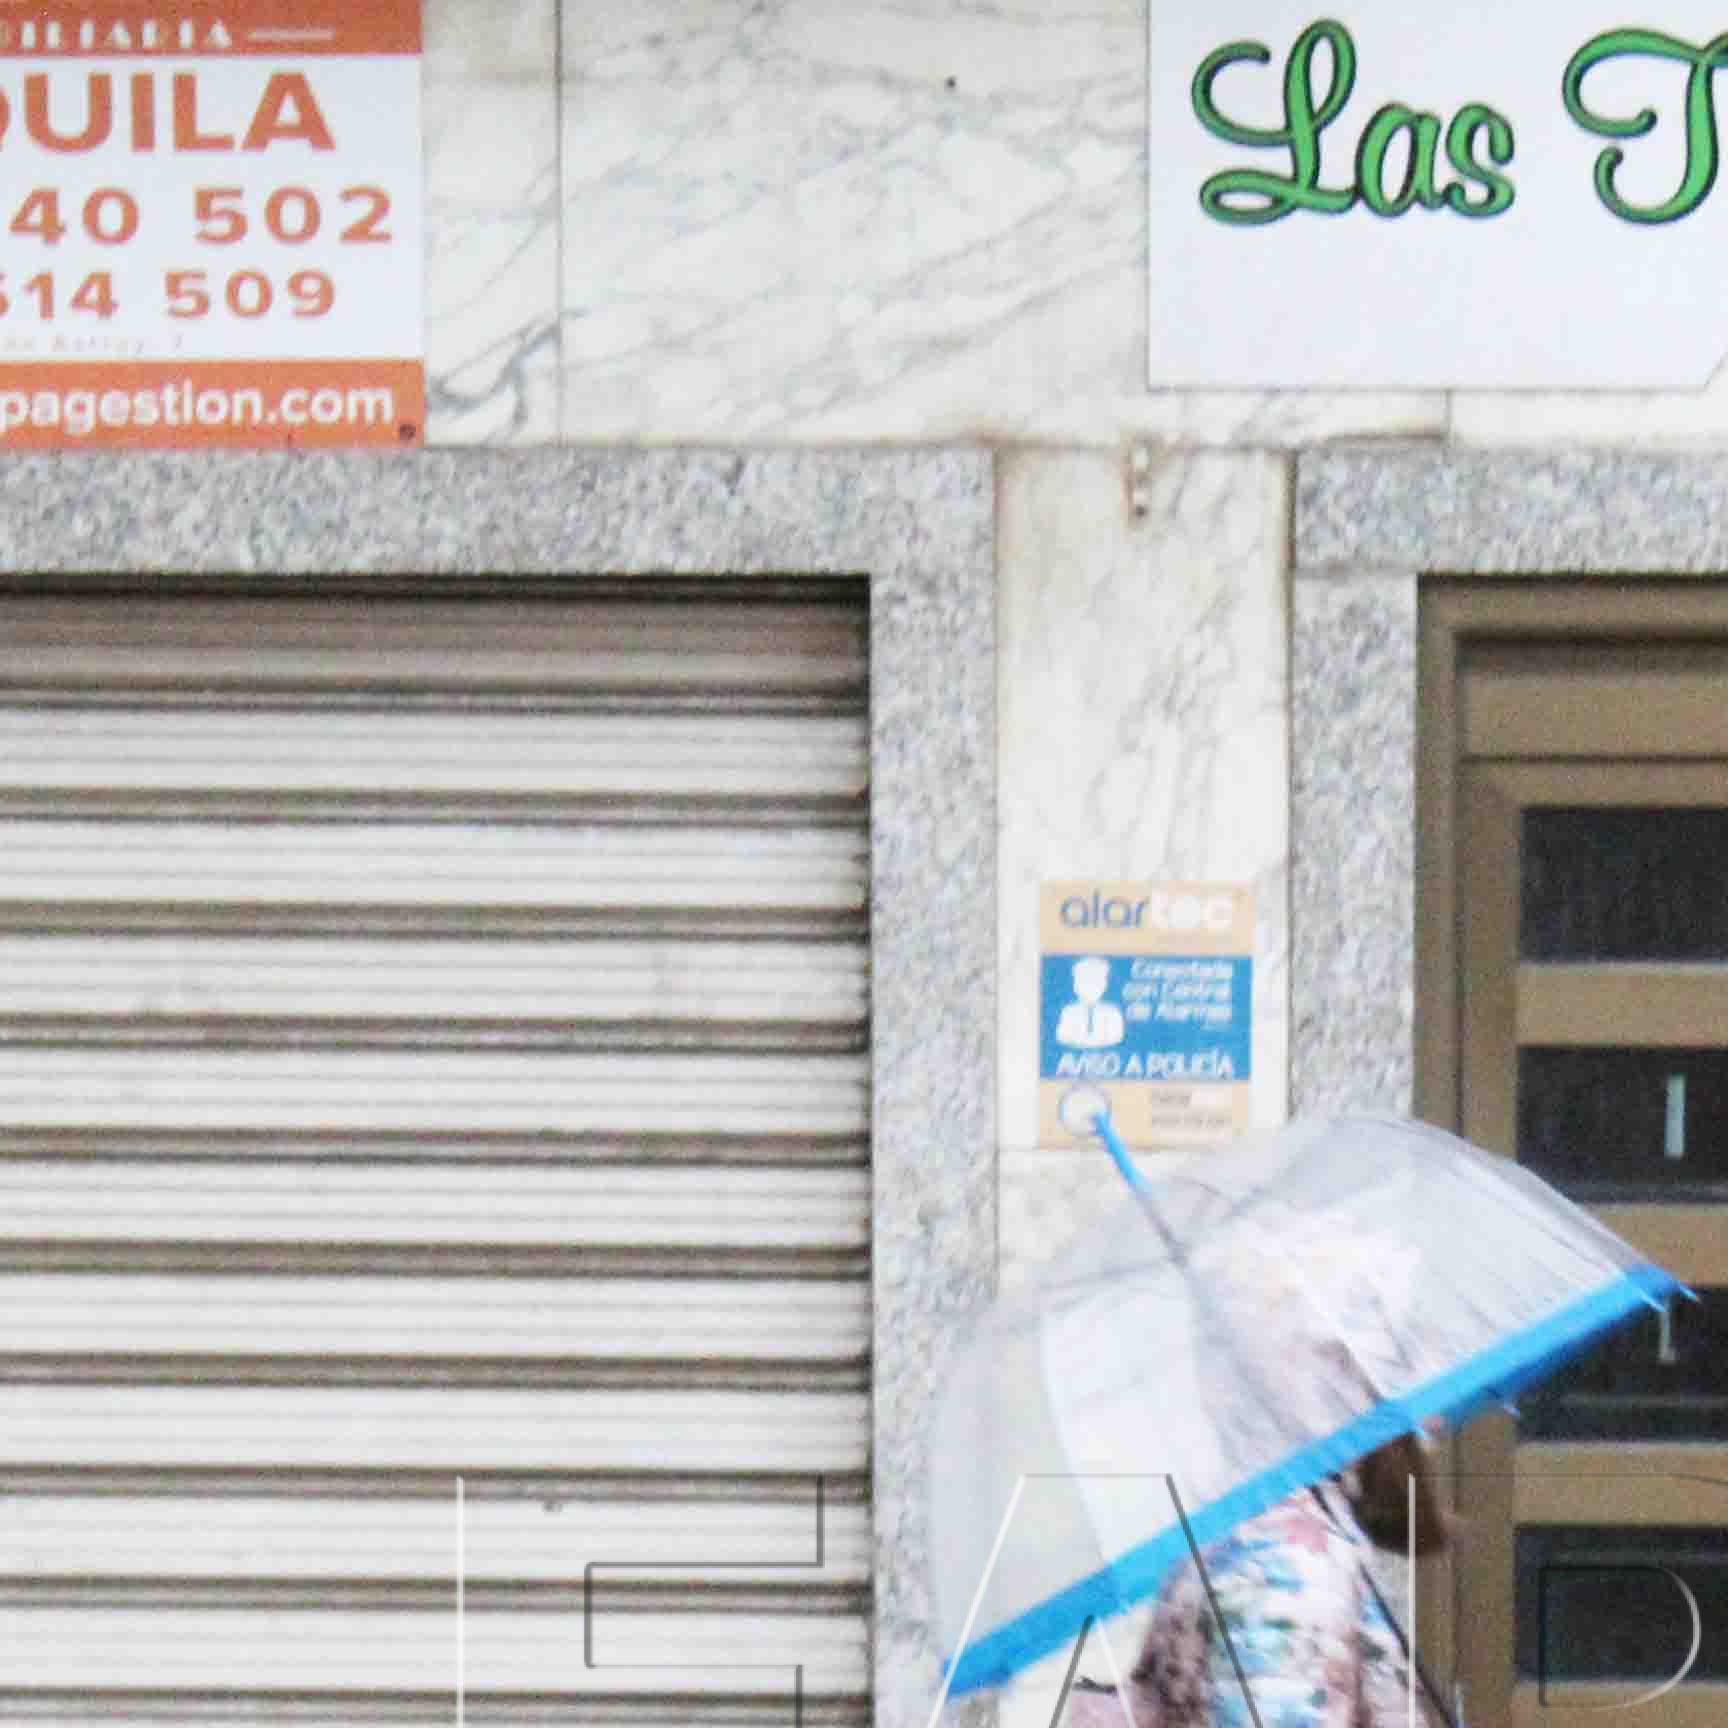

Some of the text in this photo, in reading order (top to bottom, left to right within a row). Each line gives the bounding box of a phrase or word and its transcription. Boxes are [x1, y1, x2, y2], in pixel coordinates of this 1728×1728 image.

[1191, 18, 1516, 226] Las
[193, 186, 393, 246] 502
[164, 270, 337, 320] 509
